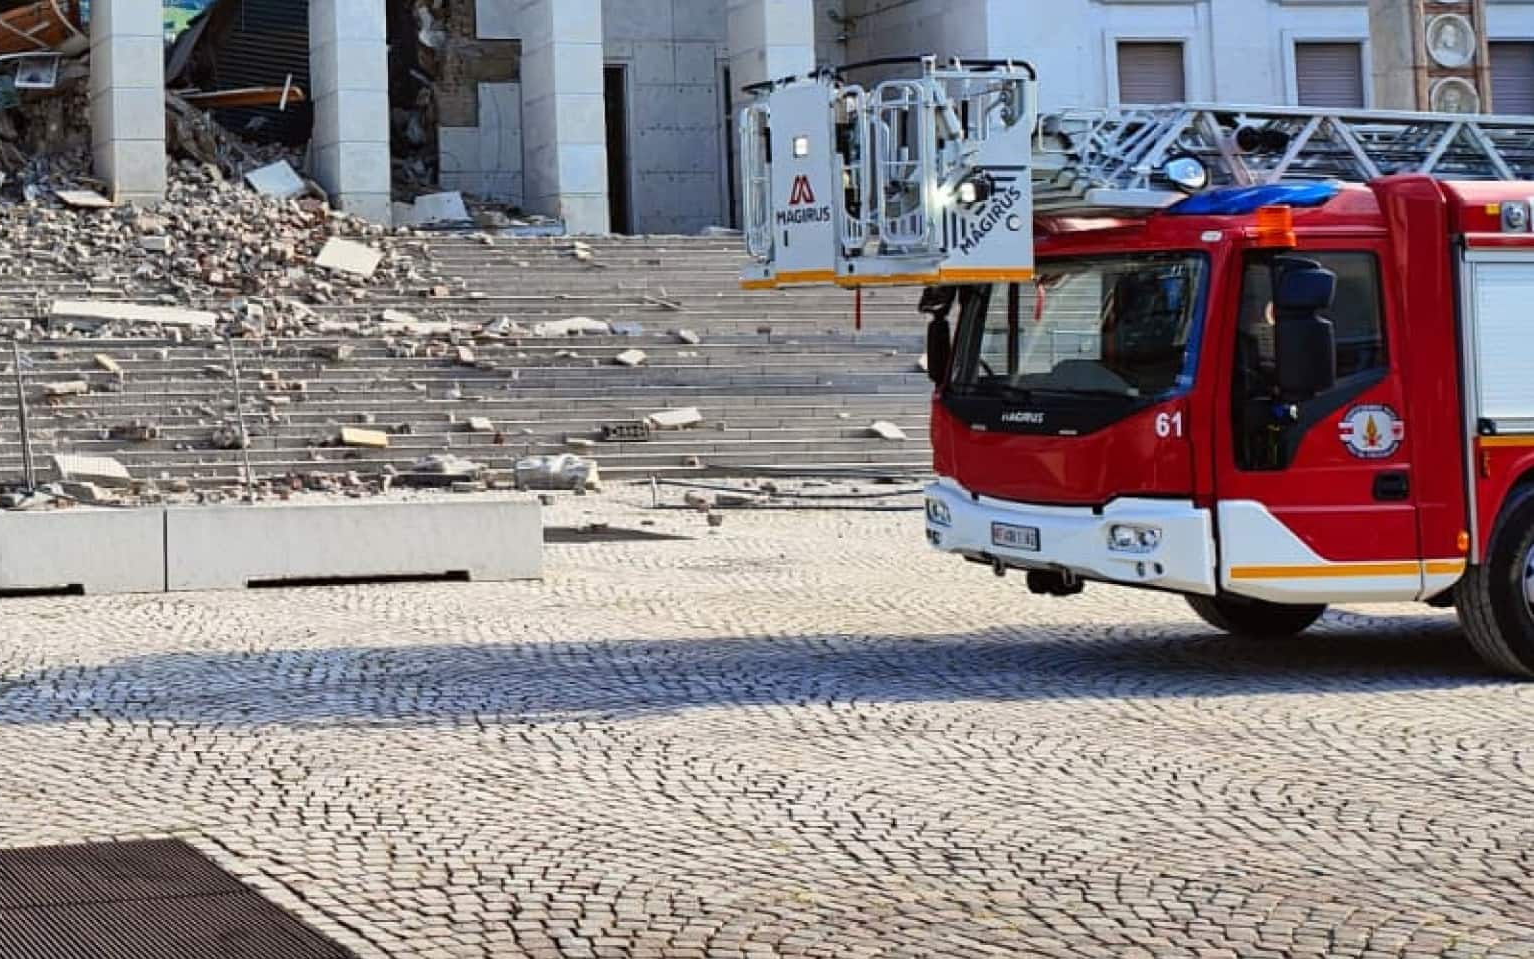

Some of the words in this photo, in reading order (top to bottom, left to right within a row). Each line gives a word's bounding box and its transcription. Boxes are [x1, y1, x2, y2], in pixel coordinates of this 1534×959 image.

[776, 206, 831, 225] MAGIRUS
[960, 185, 1021, 256] MAGIRUS
[1156, 411, 1183, 438] 61
